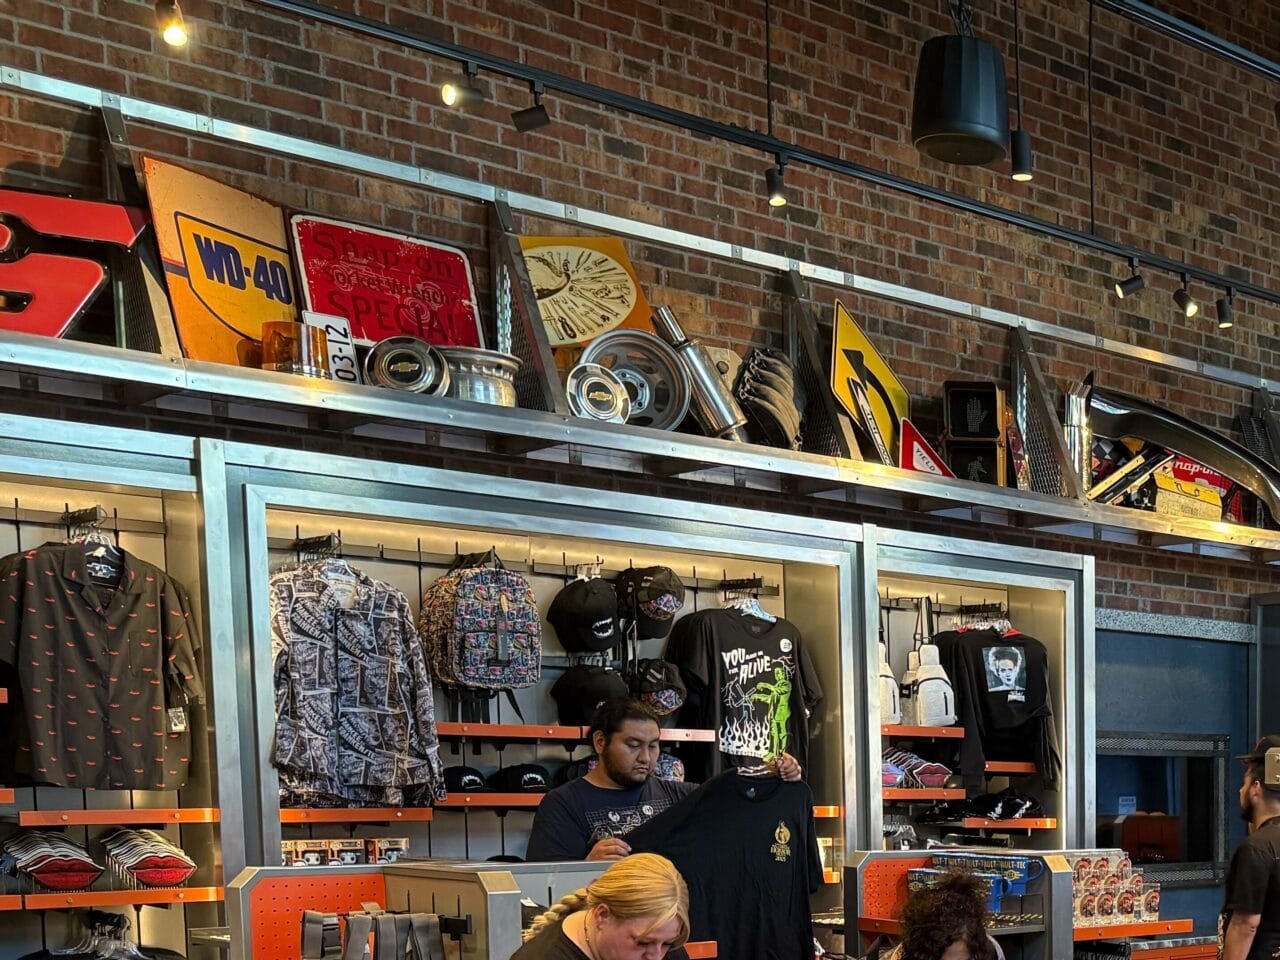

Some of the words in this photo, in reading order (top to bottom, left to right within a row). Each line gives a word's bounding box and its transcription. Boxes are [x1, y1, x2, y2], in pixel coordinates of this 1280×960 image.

[193, 233, 292, 304] WD-40
[312, 231, 453, 279] Snap-on
[325, 324, 356, 382] 03-12
[915, 447, 936, 472] YIELD
[1174, 461, 1222, 477] nap-on
[721, 648, 746, 670] YOU
[739, 655, 772, 685] ALIVE
